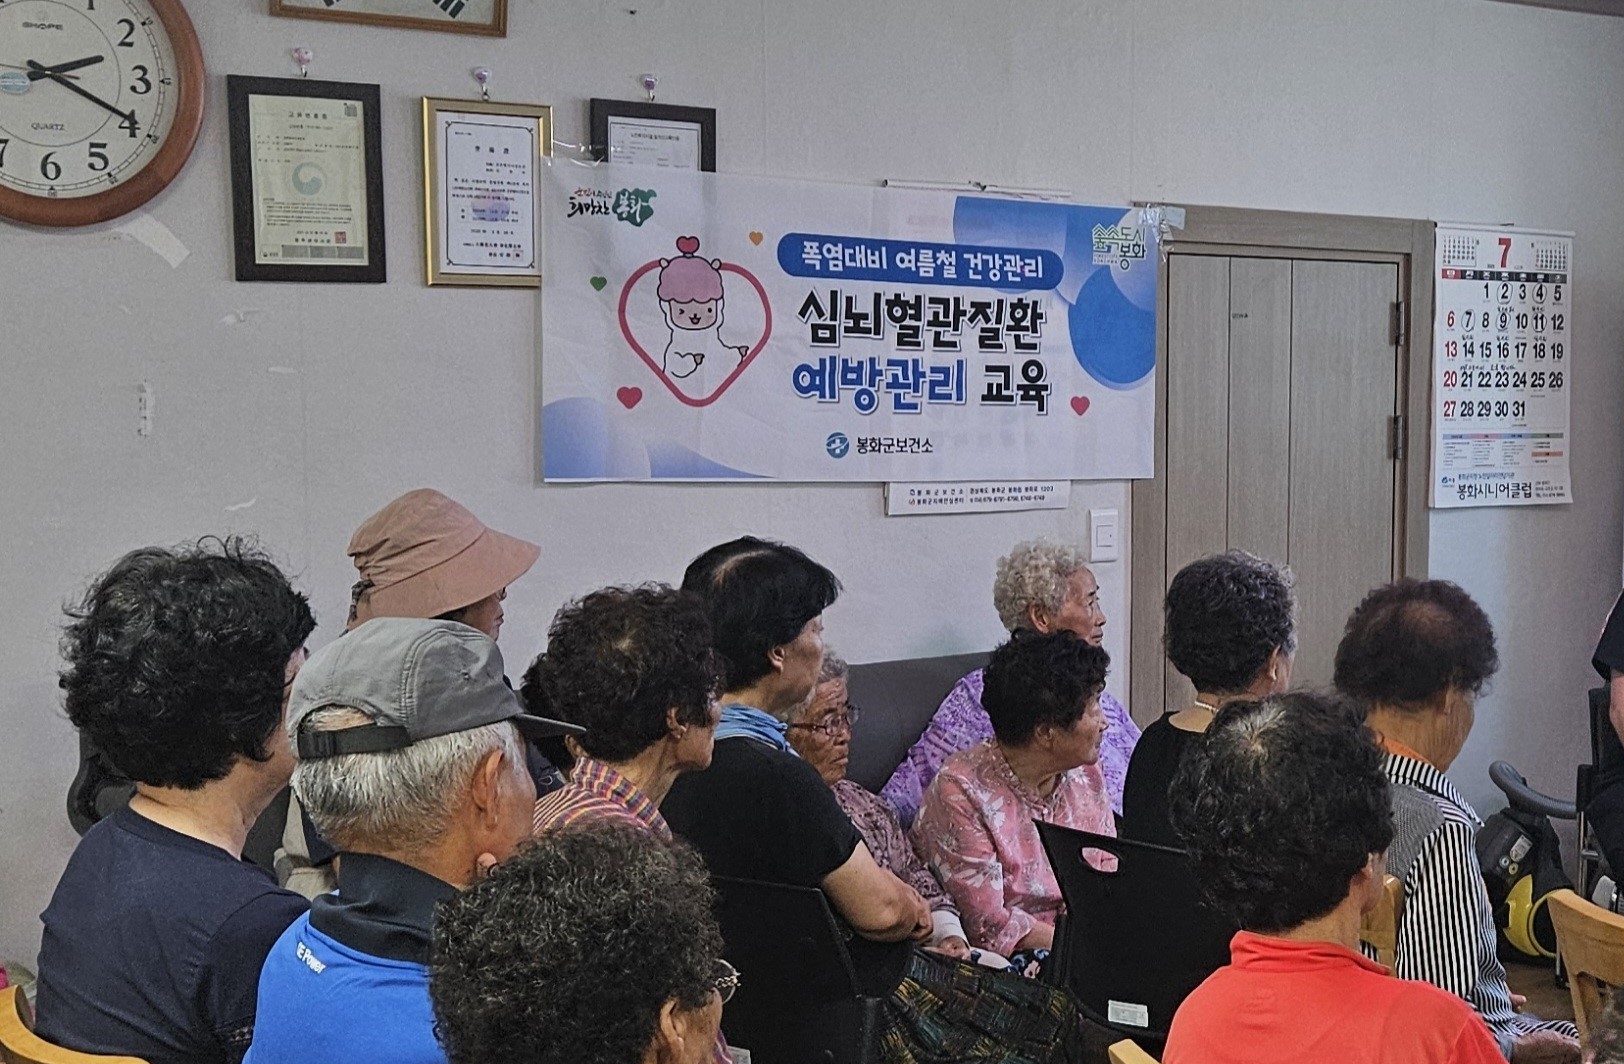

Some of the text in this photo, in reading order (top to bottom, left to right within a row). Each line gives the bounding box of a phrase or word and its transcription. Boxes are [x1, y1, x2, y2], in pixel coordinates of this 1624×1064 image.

[117, 18, 135, 47] 2
[130, 65, 152, 94] 3
[31, 123, 65, 131] QUARTZ
[118, 109, 141, 138] 4
[40, 152, 61, 180] 6
[87, 142, 109, 171] 5
[802, 240, 1043, 282] 폭염대비 여름철 건강관리
[1498, 238, 1511, 268] 7
[1484, 282, 1561, 301] 1 2 3 4 5
[797, 288, 1046, 352] 심뇌혈관질환
[1447, 311, 1564, 330] 6 7 8 9 10 11 12
[1445, 341, 1563, 359] 13 14 15 16 17 18 19
[792, 355, 1051, 413] 예방관리 교육
[1444, 371, 1563, 388] 20 21 22 23 24 25 26
[1444, 401, 1525, 417] 27 28 29 30 31
[856, 436, 934, 454] 봉화군보건소
[1457, 482, 1532, 500] 봉화시니어클럽
